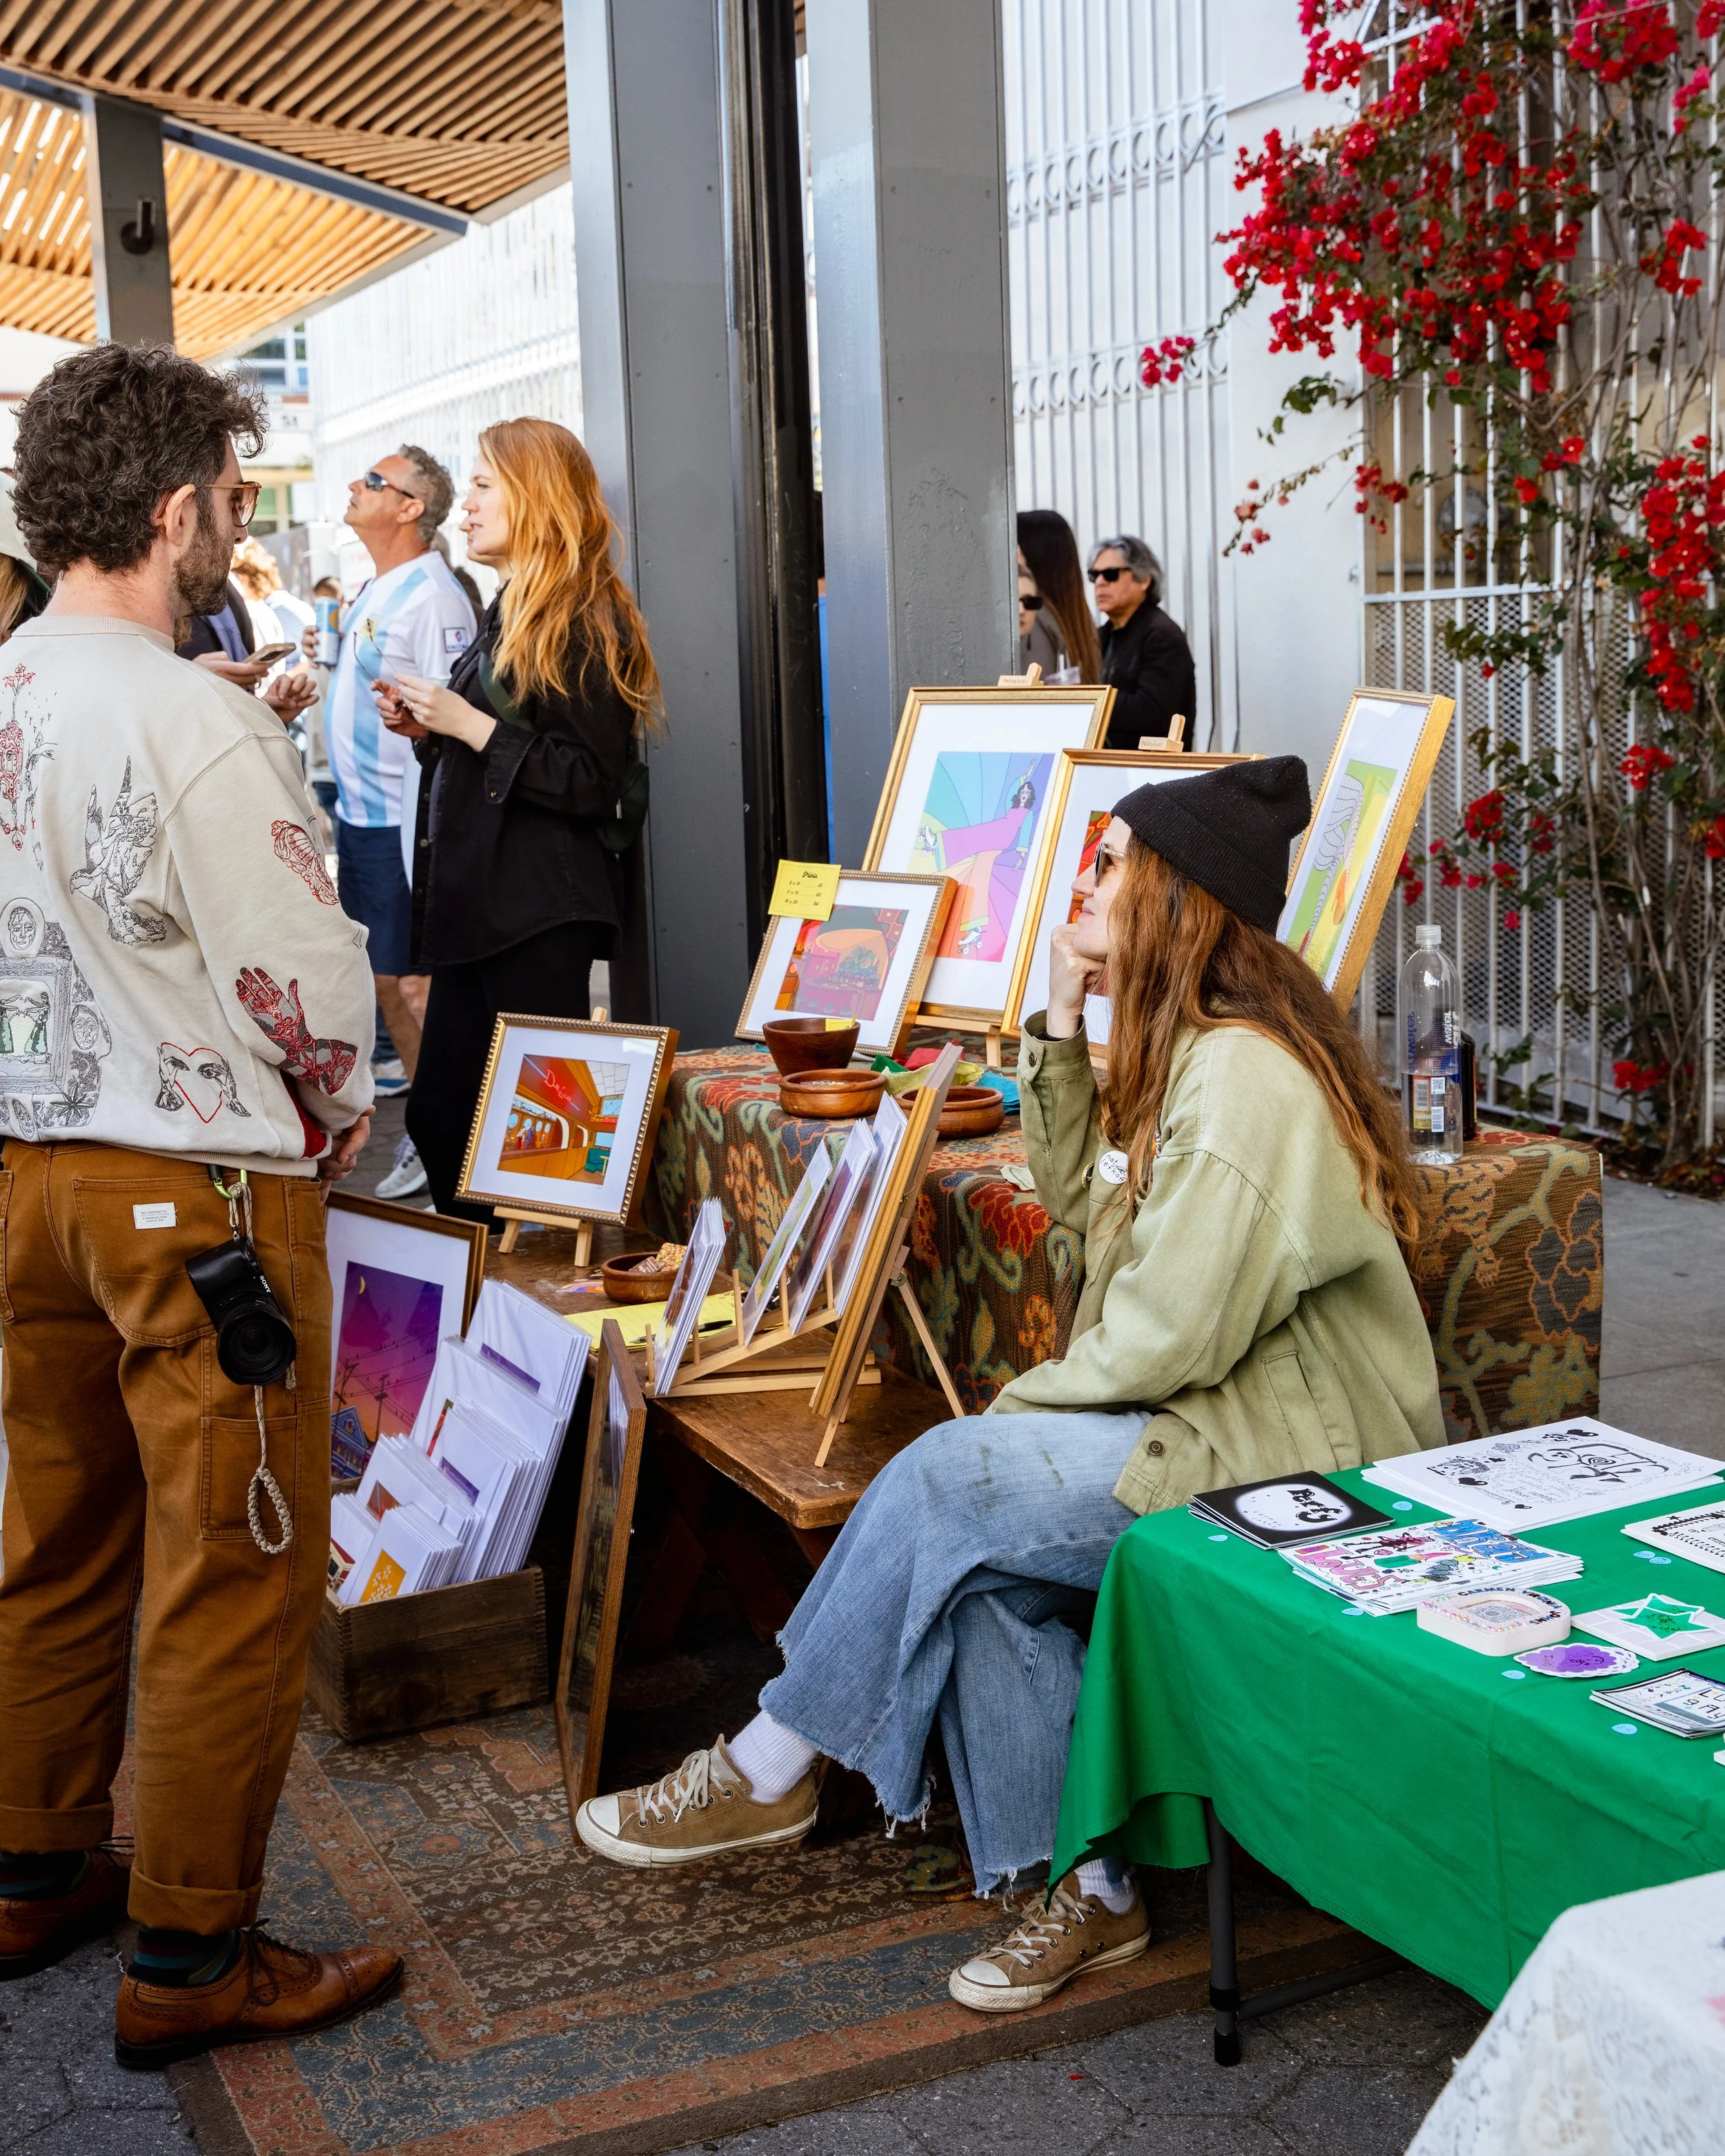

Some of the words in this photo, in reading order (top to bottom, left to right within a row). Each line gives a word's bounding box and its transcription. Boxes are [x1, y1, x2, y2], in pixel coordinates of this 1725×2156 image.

[1105, 1154, 1118, 1165] nat
[259, 1275, 271, 1293] SONY
[1457, 1587, 1516, 1596] CARMEN
[1521, 1590, 1562, 1610] VIRGINIA
